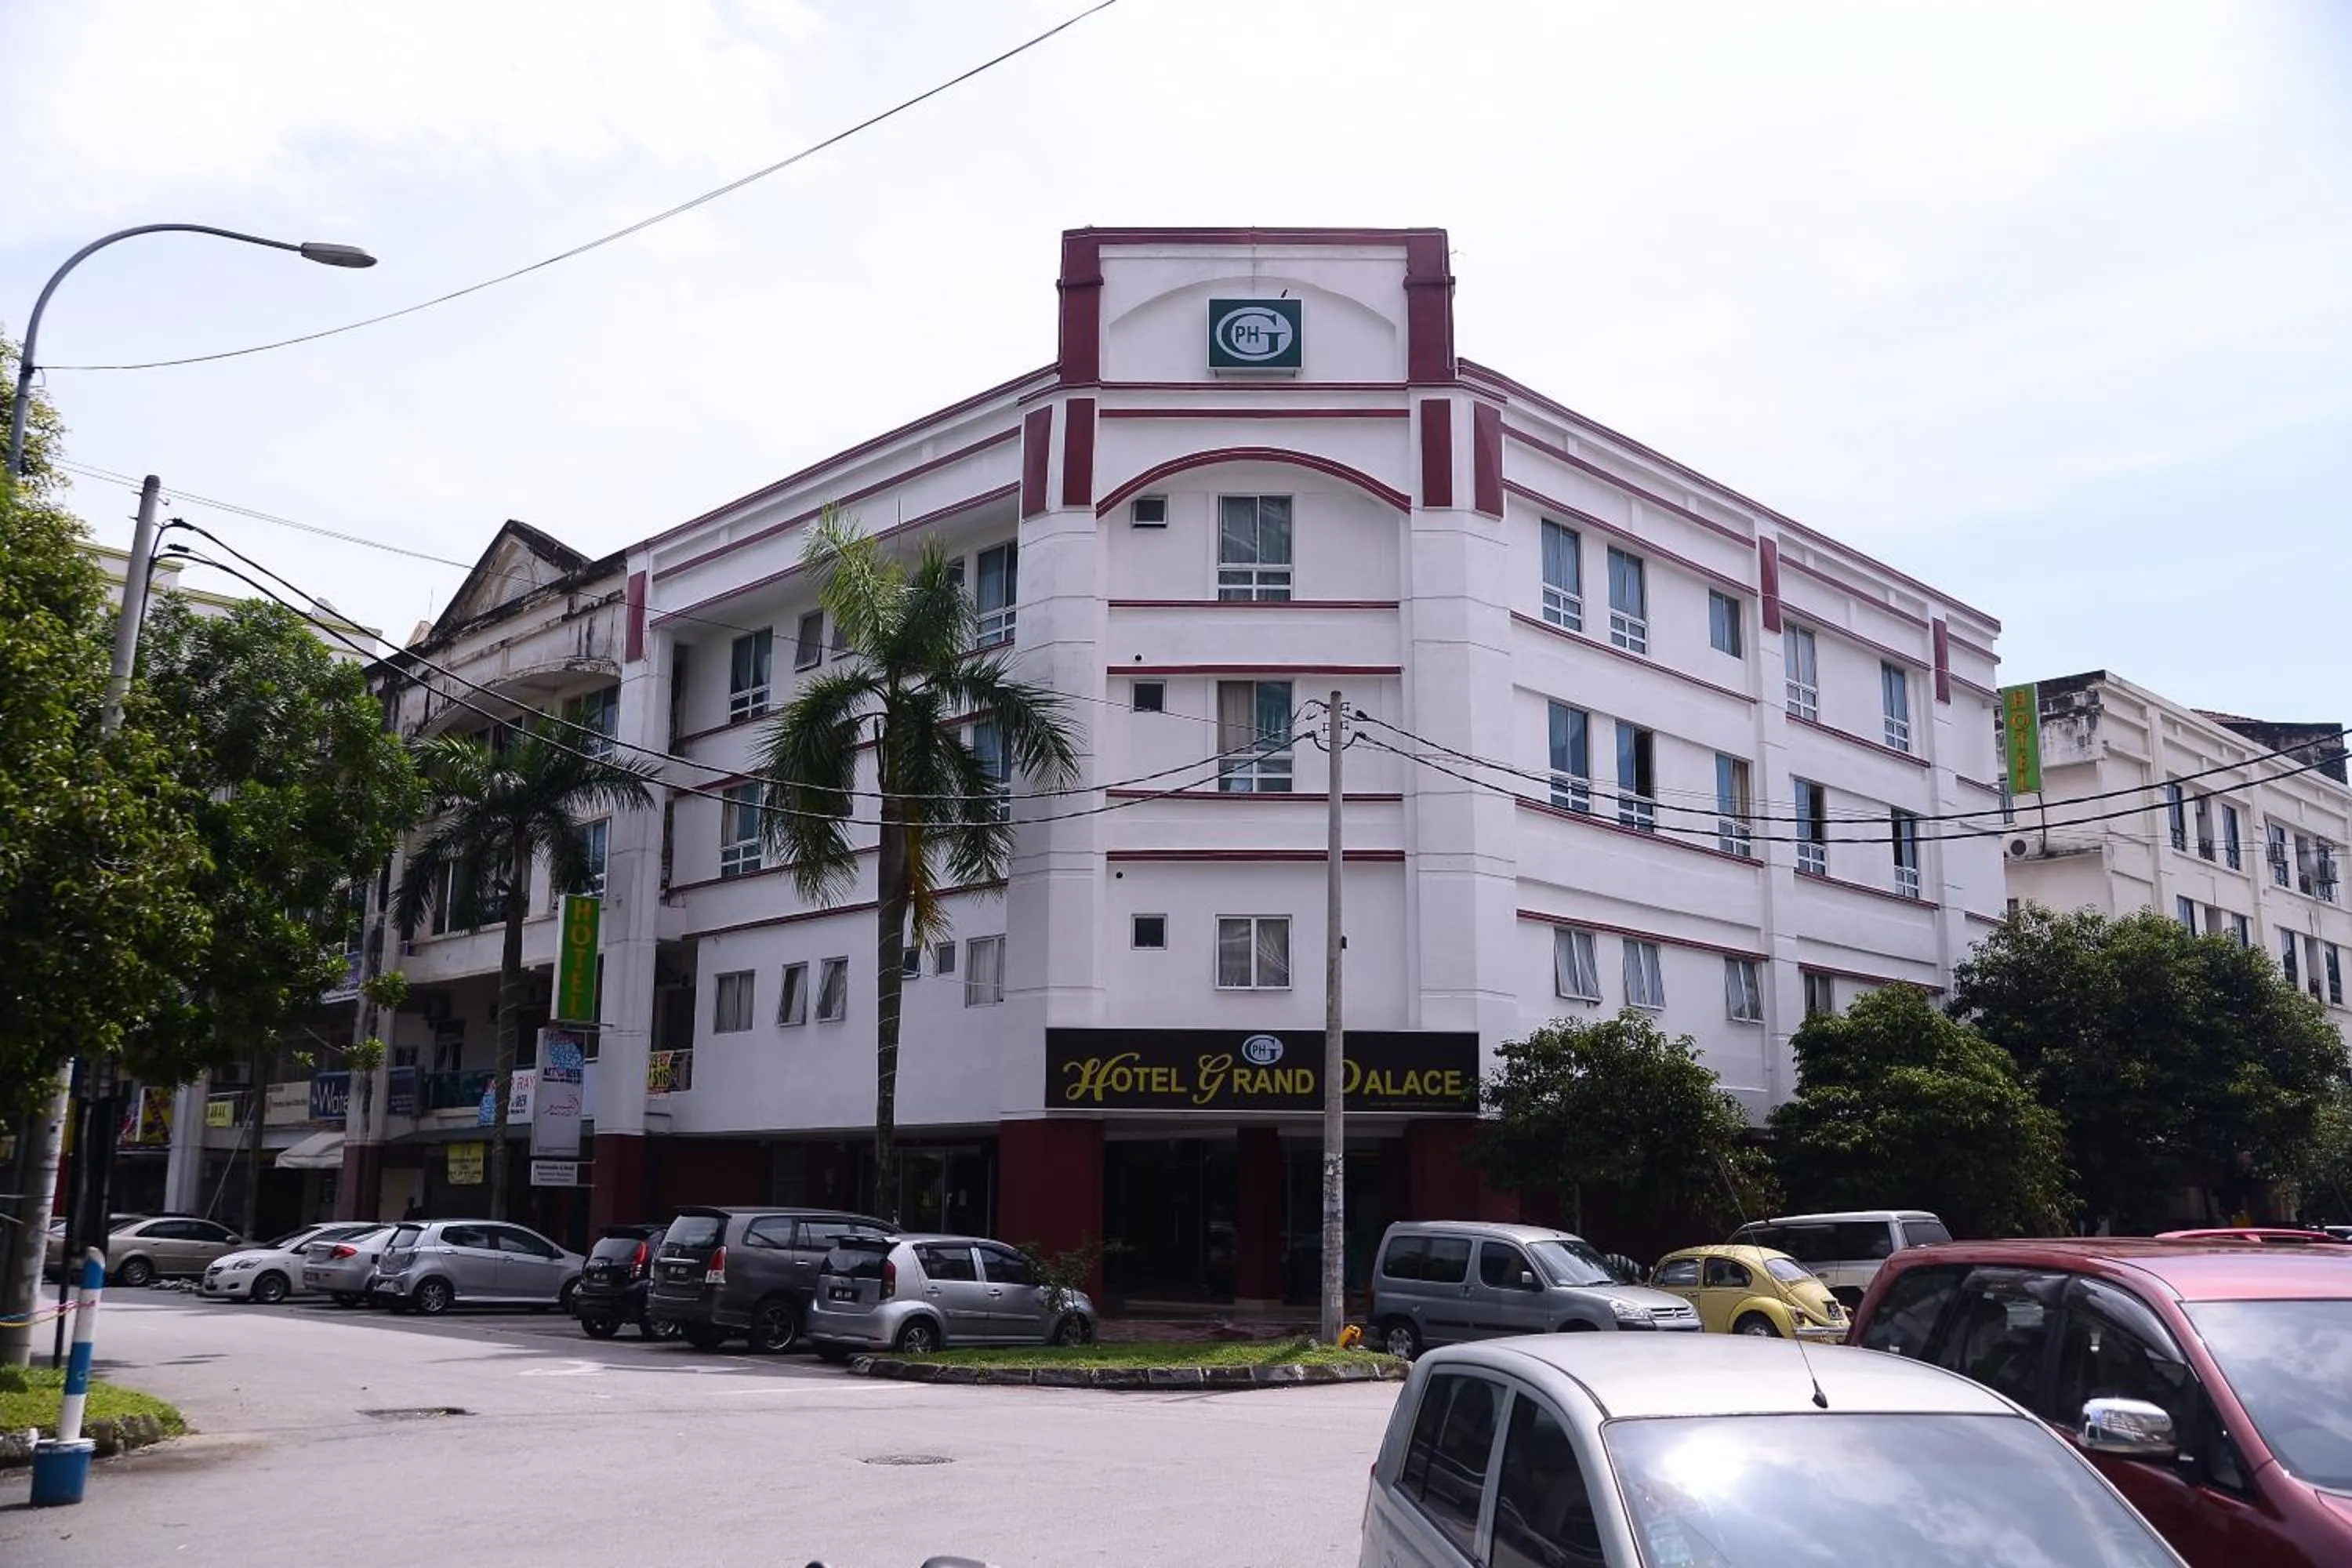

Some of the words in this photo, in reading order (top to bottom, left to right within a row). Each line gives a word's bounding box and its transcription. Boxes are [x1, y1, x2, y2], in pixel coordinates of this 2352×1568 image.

[569, 898, 593, 1018] HOTEL
[1062, 1051, 1188, 1102] HOTEL
[1192, 1053, 1316, 1105] GRAND
